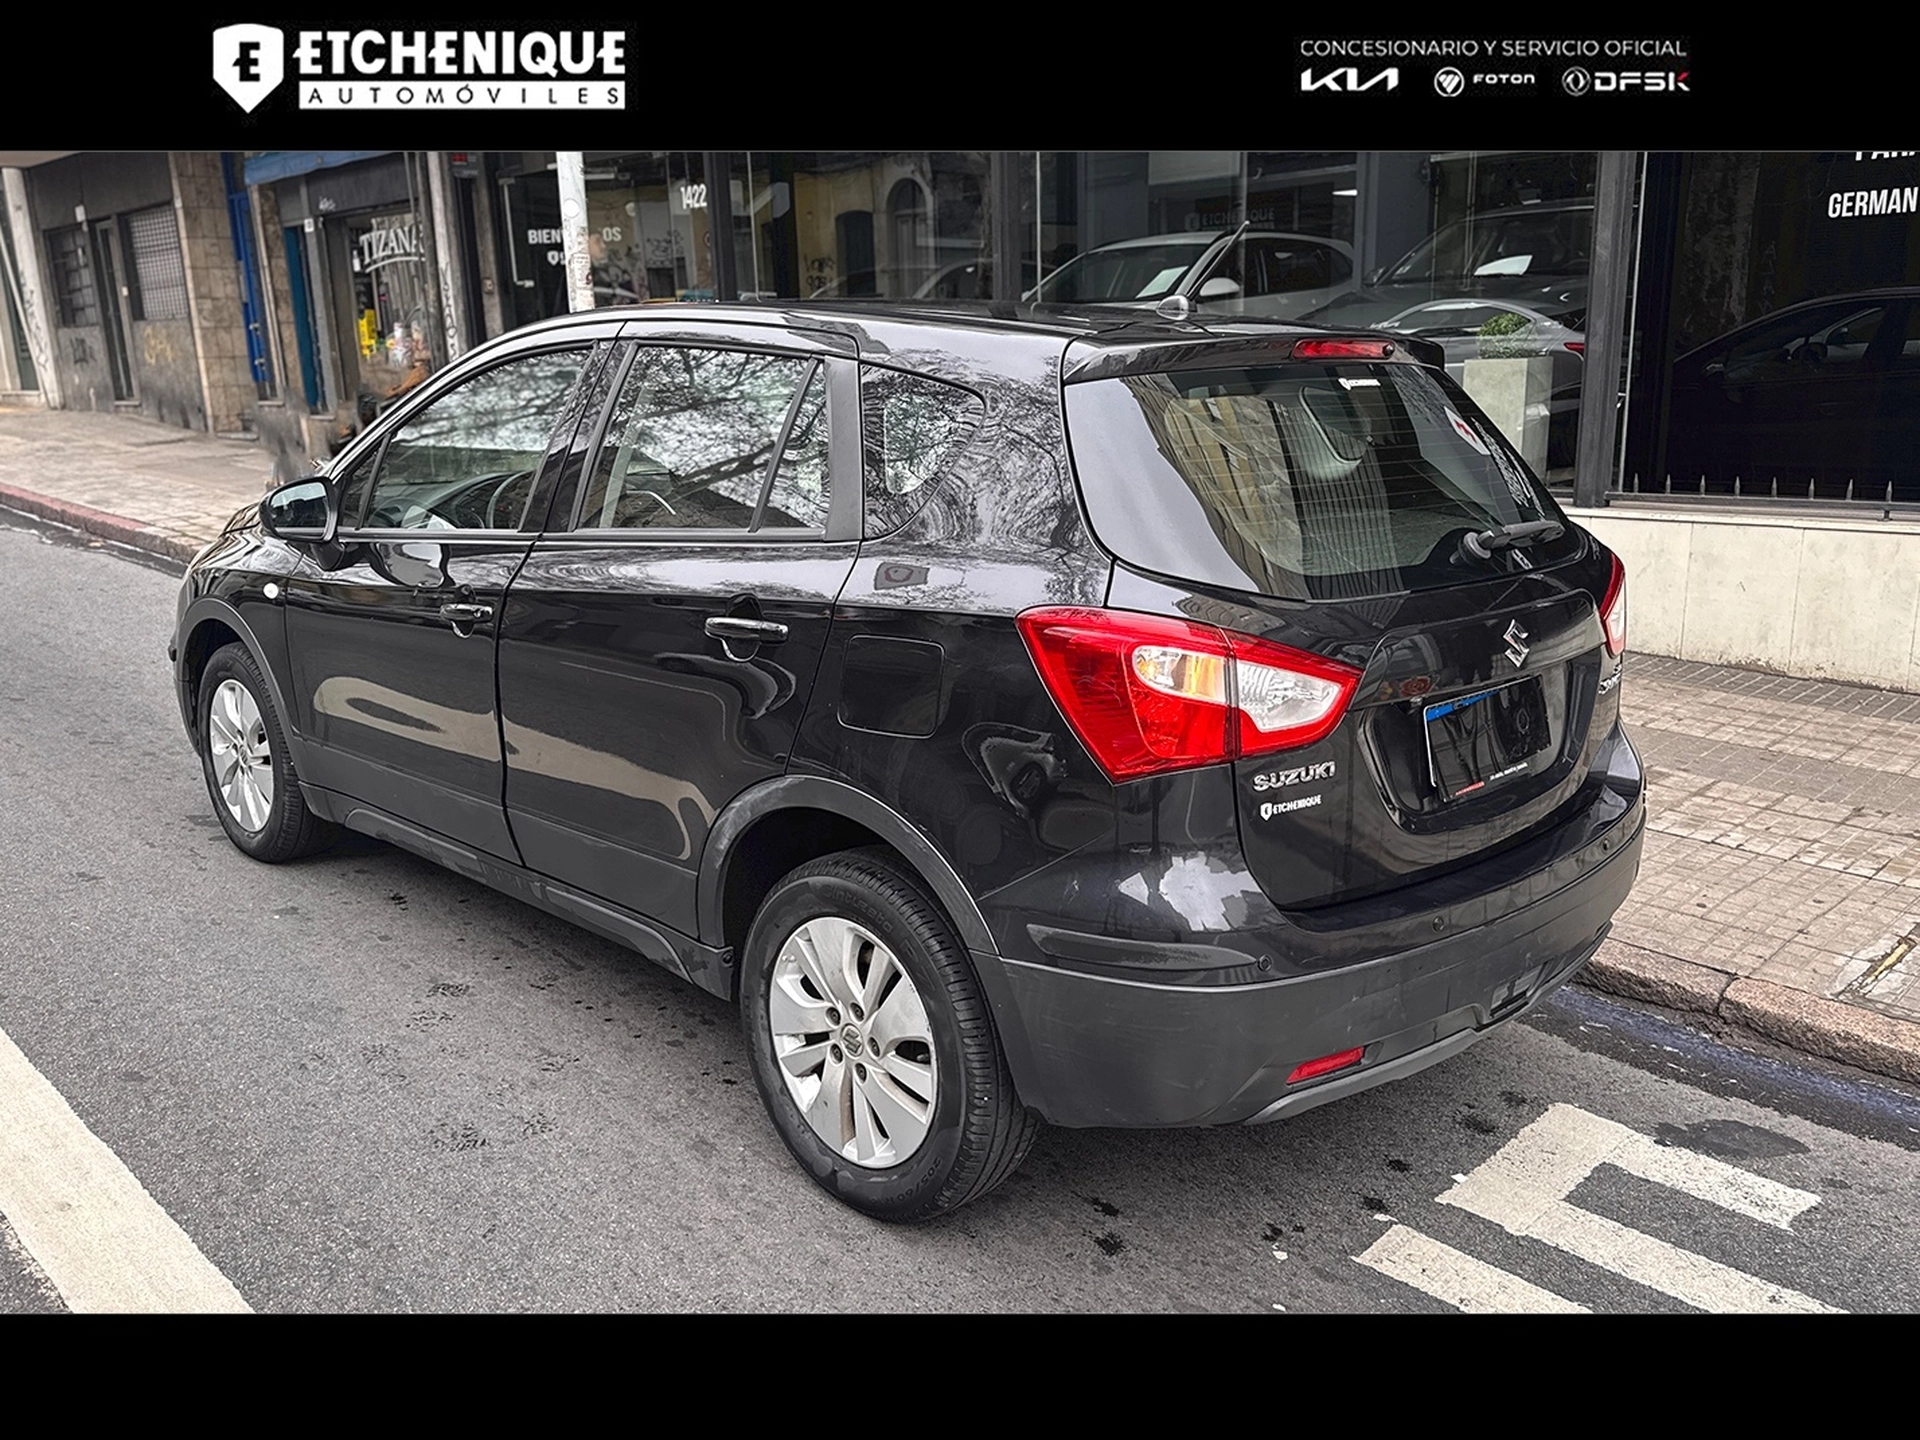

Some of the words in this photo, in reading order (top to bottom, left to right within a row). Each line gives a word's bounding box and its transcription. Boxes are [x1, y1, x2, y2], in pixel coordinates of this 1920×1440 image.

[680, 183, 708, 210] 1422
[1827, 186, 1919, 218] GERMAN
[1253, 761, 1336, 791] SUZUKI
[1272, 794, 1322, 815] ETCHENIQUE
